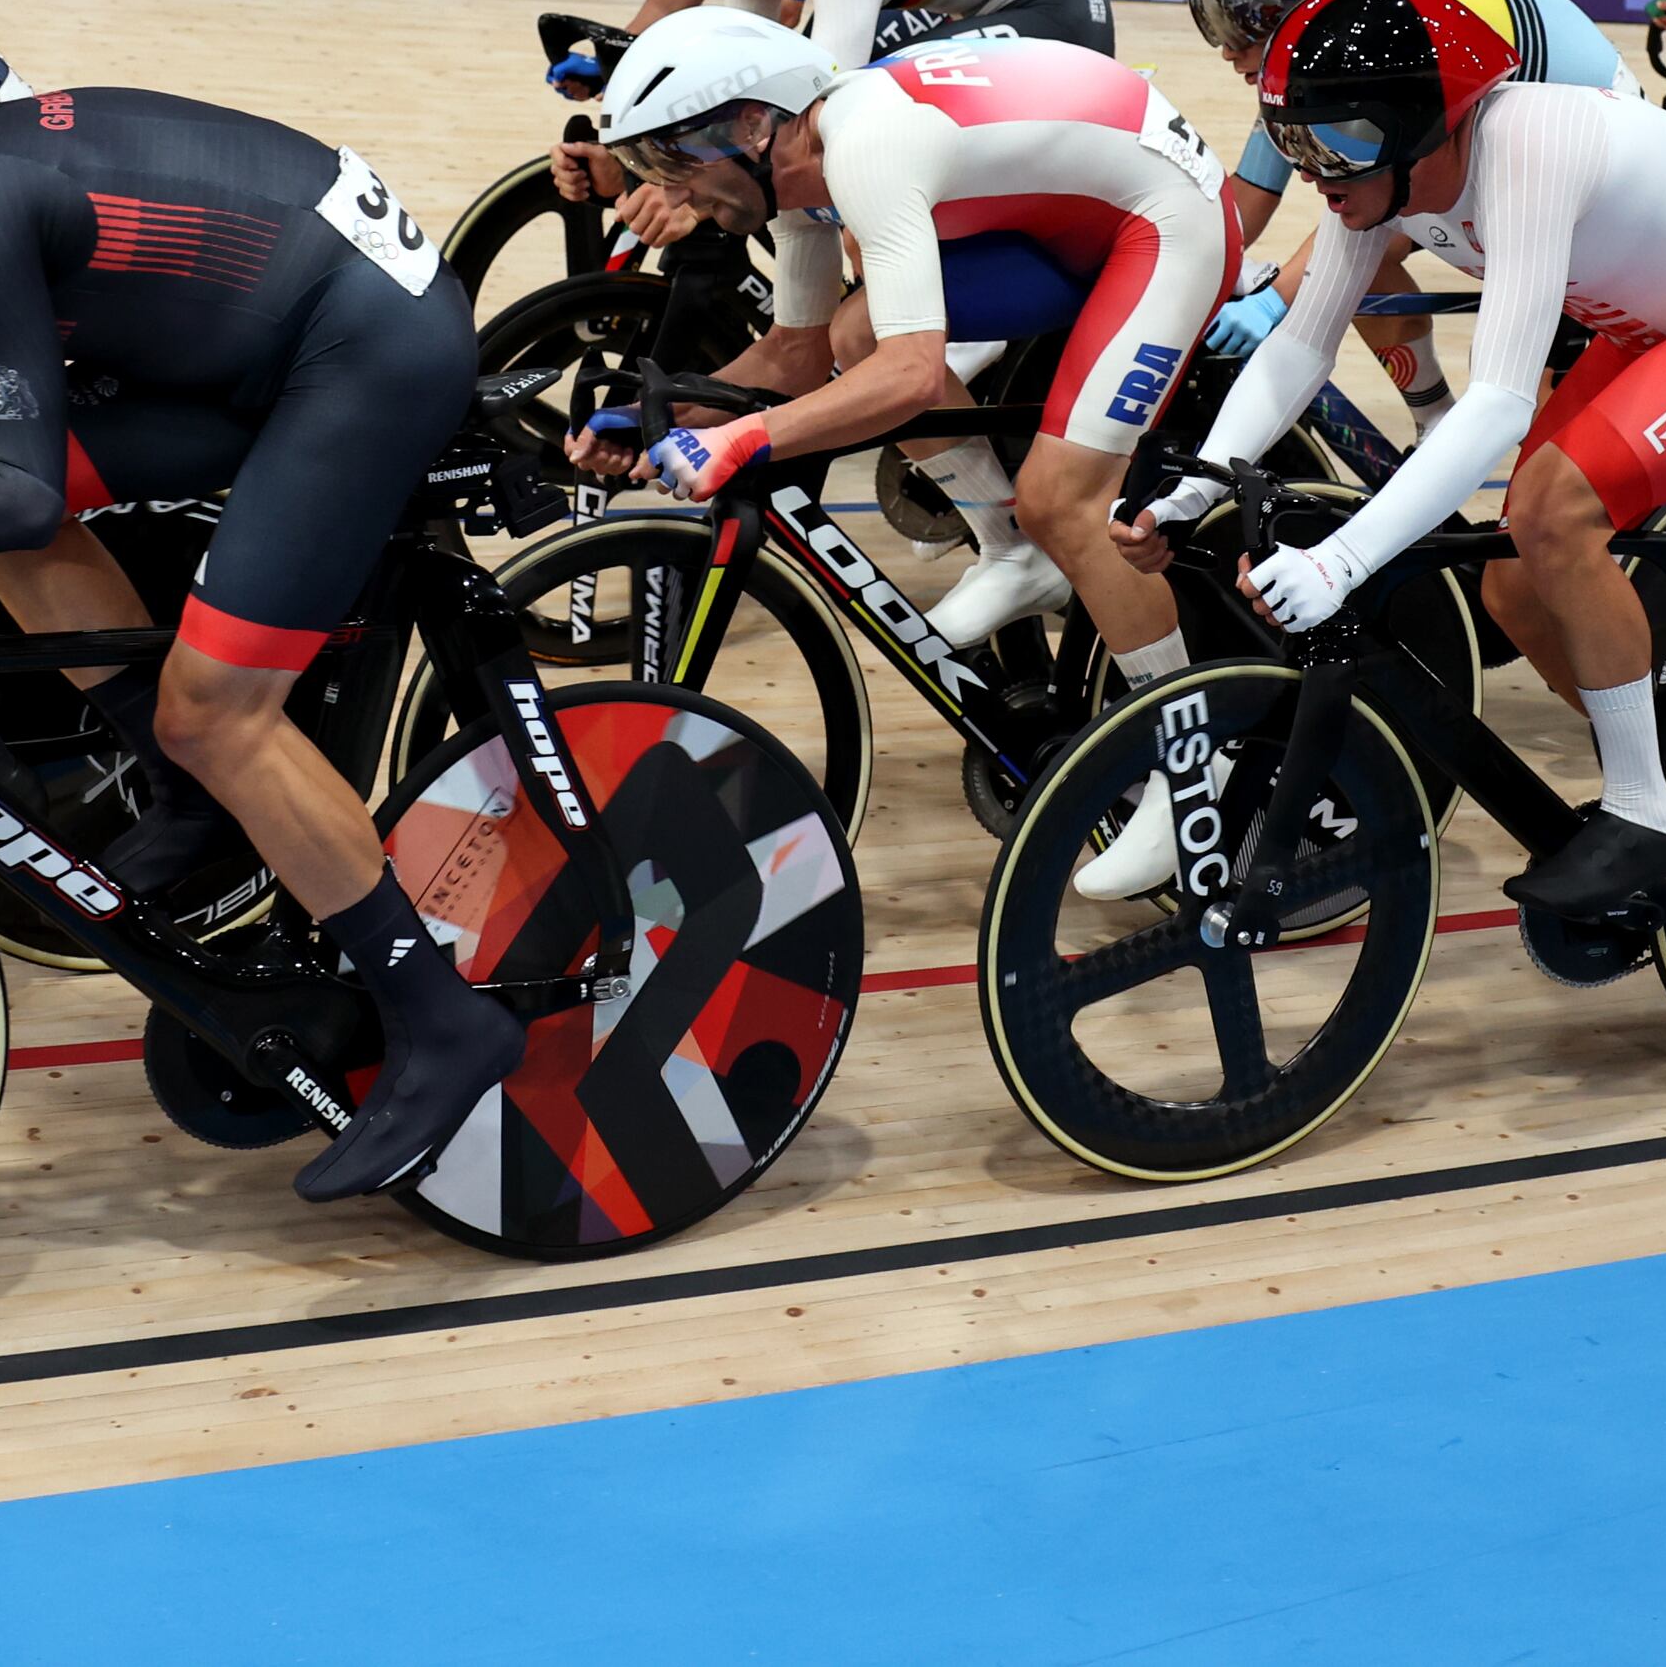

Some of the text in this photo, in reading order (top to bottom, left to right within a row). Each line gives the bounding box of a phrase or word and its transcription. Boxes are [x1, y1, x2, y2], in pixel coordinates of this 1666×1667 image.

[875, 7, 949, 49] ITAL
[666, 63, 763, 120] GIRO
[1262, 91, 1285, 107] KASK
[1104, 342, 1183, 427] FRA
[428, 462, 491, 484] RENISHAW
[669, 428, 712, 472] FRA
[643, 565, 665, 684] ORIMA
[769, 485, 989, 702] LOOK
[505, 681, 590, 828] hope
[1161, 688, 1232, 898] ESTOC
[1266, 879, 1283, 897] 59
[286, 1065, 354, 1132] RENISH
